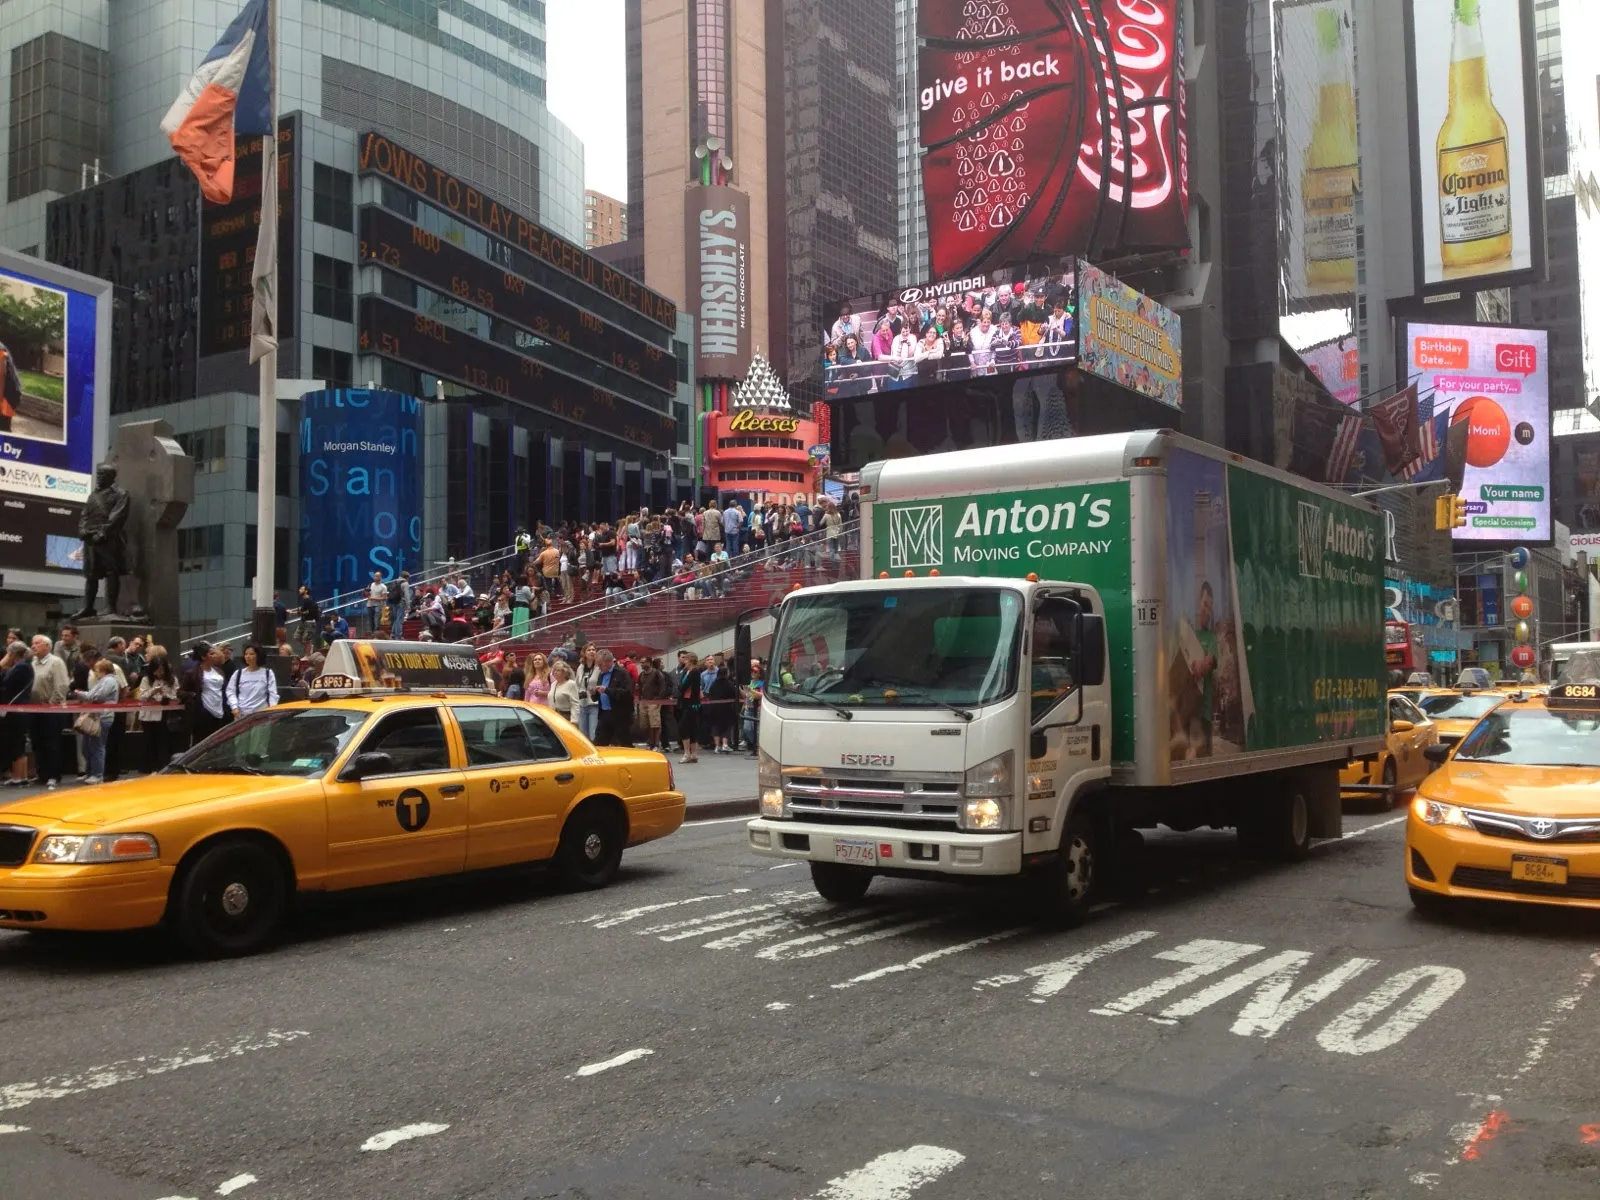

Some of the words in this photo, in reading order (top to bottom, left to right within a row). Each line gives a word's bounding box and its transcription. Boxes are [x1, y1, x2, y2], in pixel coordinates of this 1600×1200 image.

[921, 76, 968, 110] give
[976, 67, 992, 88] it
[1000, 54, 1060, 82] back
[1442, 169, 1506, 197] Corona
[1456, 193, 1494, 215] Light
[432, 168, 461, 209] TO
[467, 188, 513, 239] PLAY
[518, 217, 597, 287] PEACEFUL
[602, 267, 637, 308] ROLE
[641, 286, 653, 317] IN
[700, 209, 737, 355] HERSHEY'S
[925, 275, 986, 299] HYUNDAI
[1096, 300, 1119, 328] MAKE
[1121, 313, 1126, 330] A
[1128, 317, 1162, 350] PLAYDATE
[1097, 319, 1117, 347] WITH
[1120, 331, 1138, 355] YOUR
[1139, 342, 1156, 366] OWN
[1420, 341, 1463, 356] Birthday
[1421, 354, 1453, 365] Date...
[1500, 349, 1531, 368] Gift
[1439, 378, 1456, 389] For
[1460, 382, 1481, 391] your
[1483, 382, 1518, 393] party...
[730, 409, 799, 432] Reese's
[1473, 425, 1500, 435] Mom!
[1522, 429, 1531, 438] m
[4, 443, 22, 459] Day
[323, 441, 359, 454] Morgan
[360, 441, 396, 455] Stanley
[6, 468, 41, 484] AERVA
[1484, 486, 1509, 497] Your
[1511, 489, 1540, 498] name
[48, 506, 72, 516] weather
[954, 493, 1112, 538] Anton's
[1474, 518, 1499, 527] Special
[1501, 518, 1534, 526] Occasions
[1325, 512, 1374, 562] Anton's
[1383, 509, 1401, 562] R
[1521, 603, 1529, 611] m
[385, 653, 400, 669] IT'S
[401, 653, 423, 669] YOUR
[424, 654, 442, 670] SHOT
[1519, 652, 1529, 661] m
[449, 662, 478, 671] HONEY
[323, 676, 343, 688] 8P63
[1565, 685, 1596, 697] 8G84
[840, 753, 895, 767] ISUZU
[377, 799, 394, 808] NYC
[403, 796, 423, 827] T
